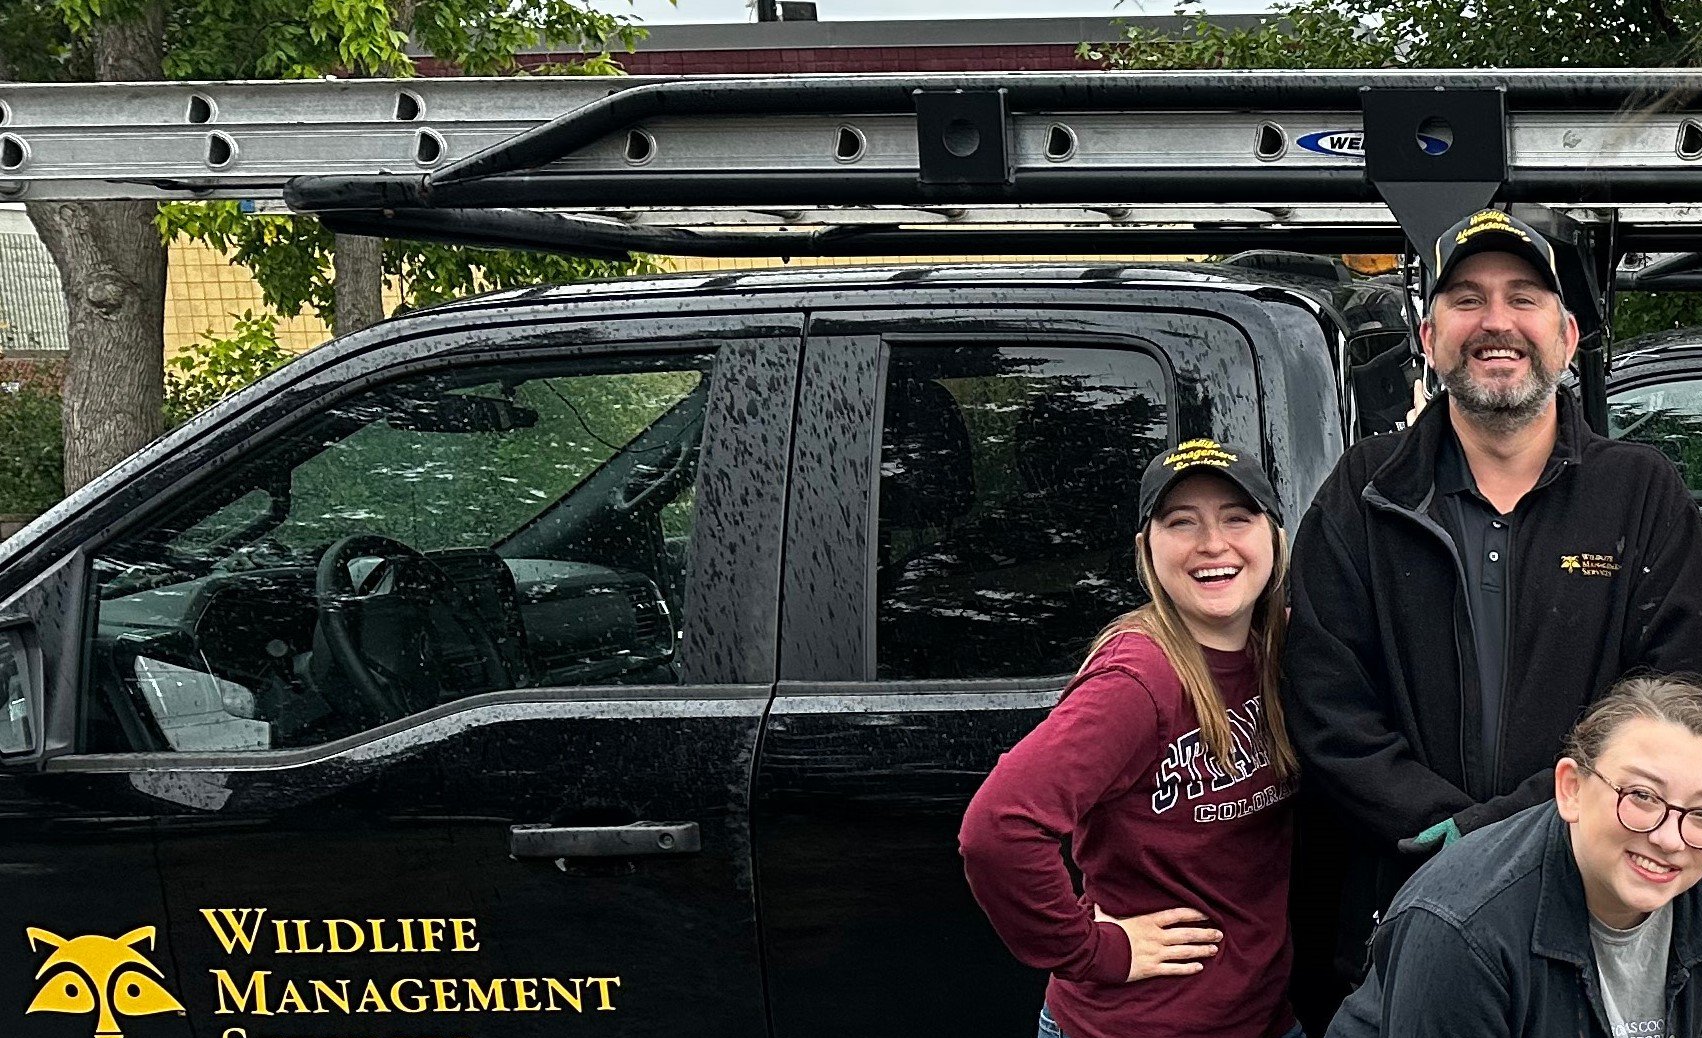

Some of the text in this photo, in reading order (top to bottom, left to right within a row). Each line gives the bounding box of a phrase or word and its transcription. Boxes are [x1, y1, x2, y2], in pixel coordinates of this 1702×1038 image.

[1194, 773, 1300, 823] COLORA
[199, 907, 480, 955] WILDLIFE
[209, 968, 621, 1016] MANAGEMENT
